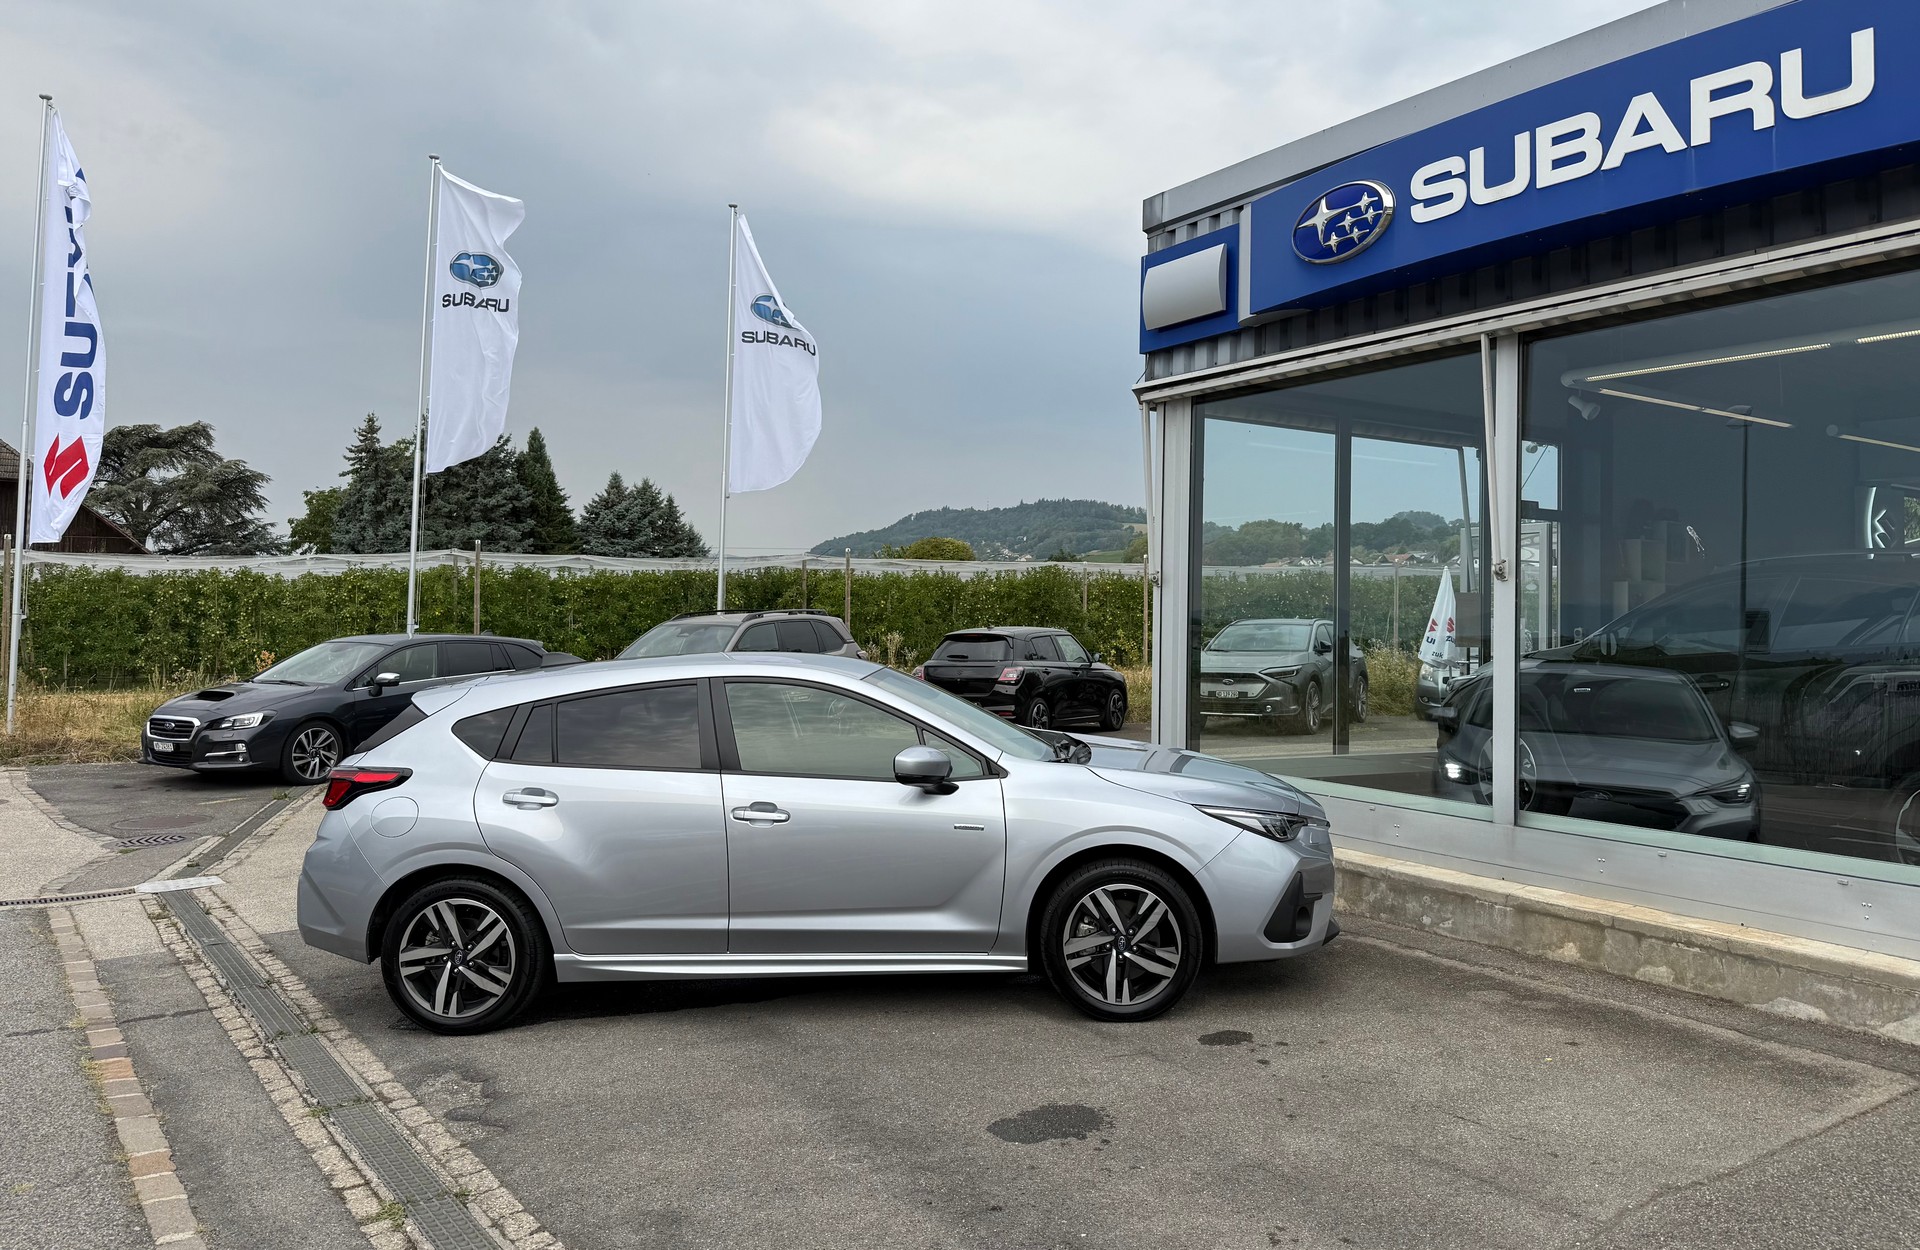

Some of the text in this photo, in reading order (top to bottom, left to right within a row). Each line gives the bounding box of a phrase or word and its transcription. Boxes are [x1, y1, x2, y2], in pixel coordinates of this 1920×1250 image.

[1410, 27, 1875, 223] SUBARU
[442, 292, 509, 313] SUBARU
[741, 330, 816, 356] SUBARU
